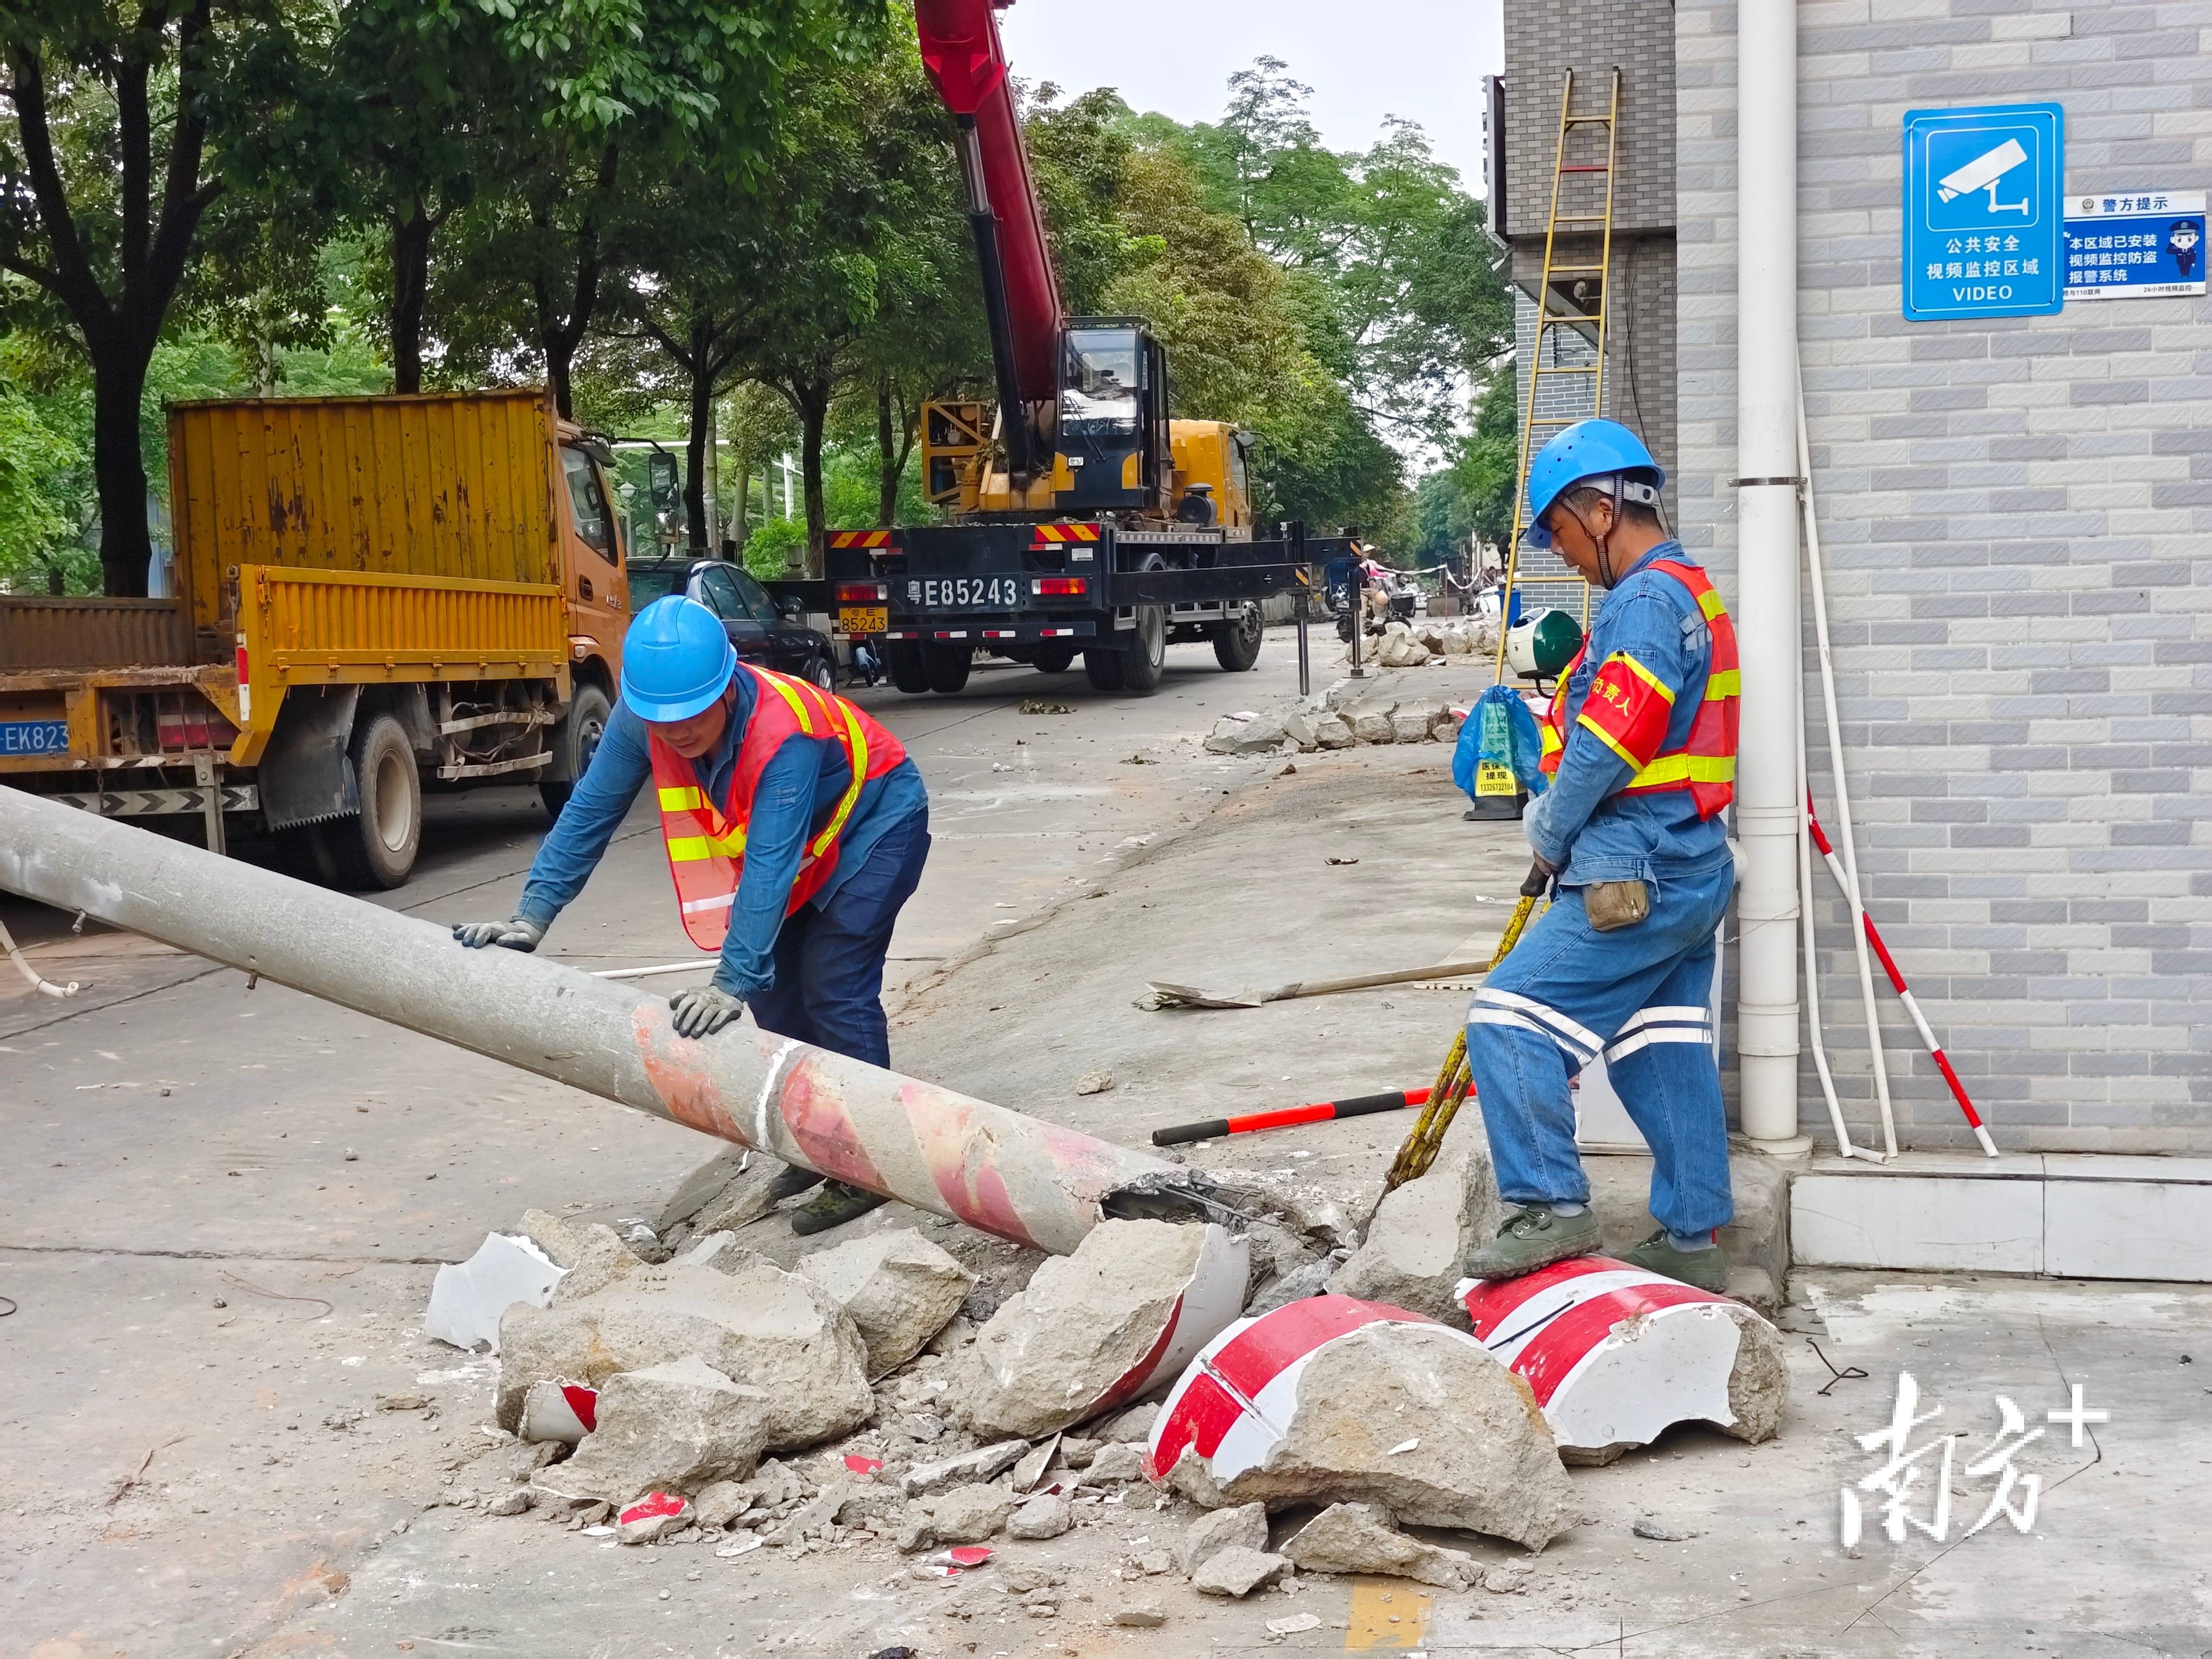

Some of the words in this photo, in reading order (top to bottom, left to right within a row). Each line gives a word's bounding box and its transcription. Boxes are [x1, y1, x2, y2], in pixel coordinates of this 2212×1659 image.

[2102, 196, 2168, 212] 警方提示
[1945, 234, 2020, 254] 公共安全
[2069, 234, 2157, 251] 本区域已安装
[2068, 250, 2157, 268] 视频监控防盗
[1926, 258, 2039, 280] 视频监控区域
[2068, 268, 2128, 284] 报警系统
[1952, 285, 2013, 301] VIDEO
[2143, 285, 2192, 293] 24小时视频监控
[907, 578, 1017, 606] 粤E85243
[842, 617, 886, 631] 85243
[1591, 677, 1631, 717] 负责人
[1485, 771, 1508, 780] 提现
[1480, 783, 1514, 792] 13326722104
